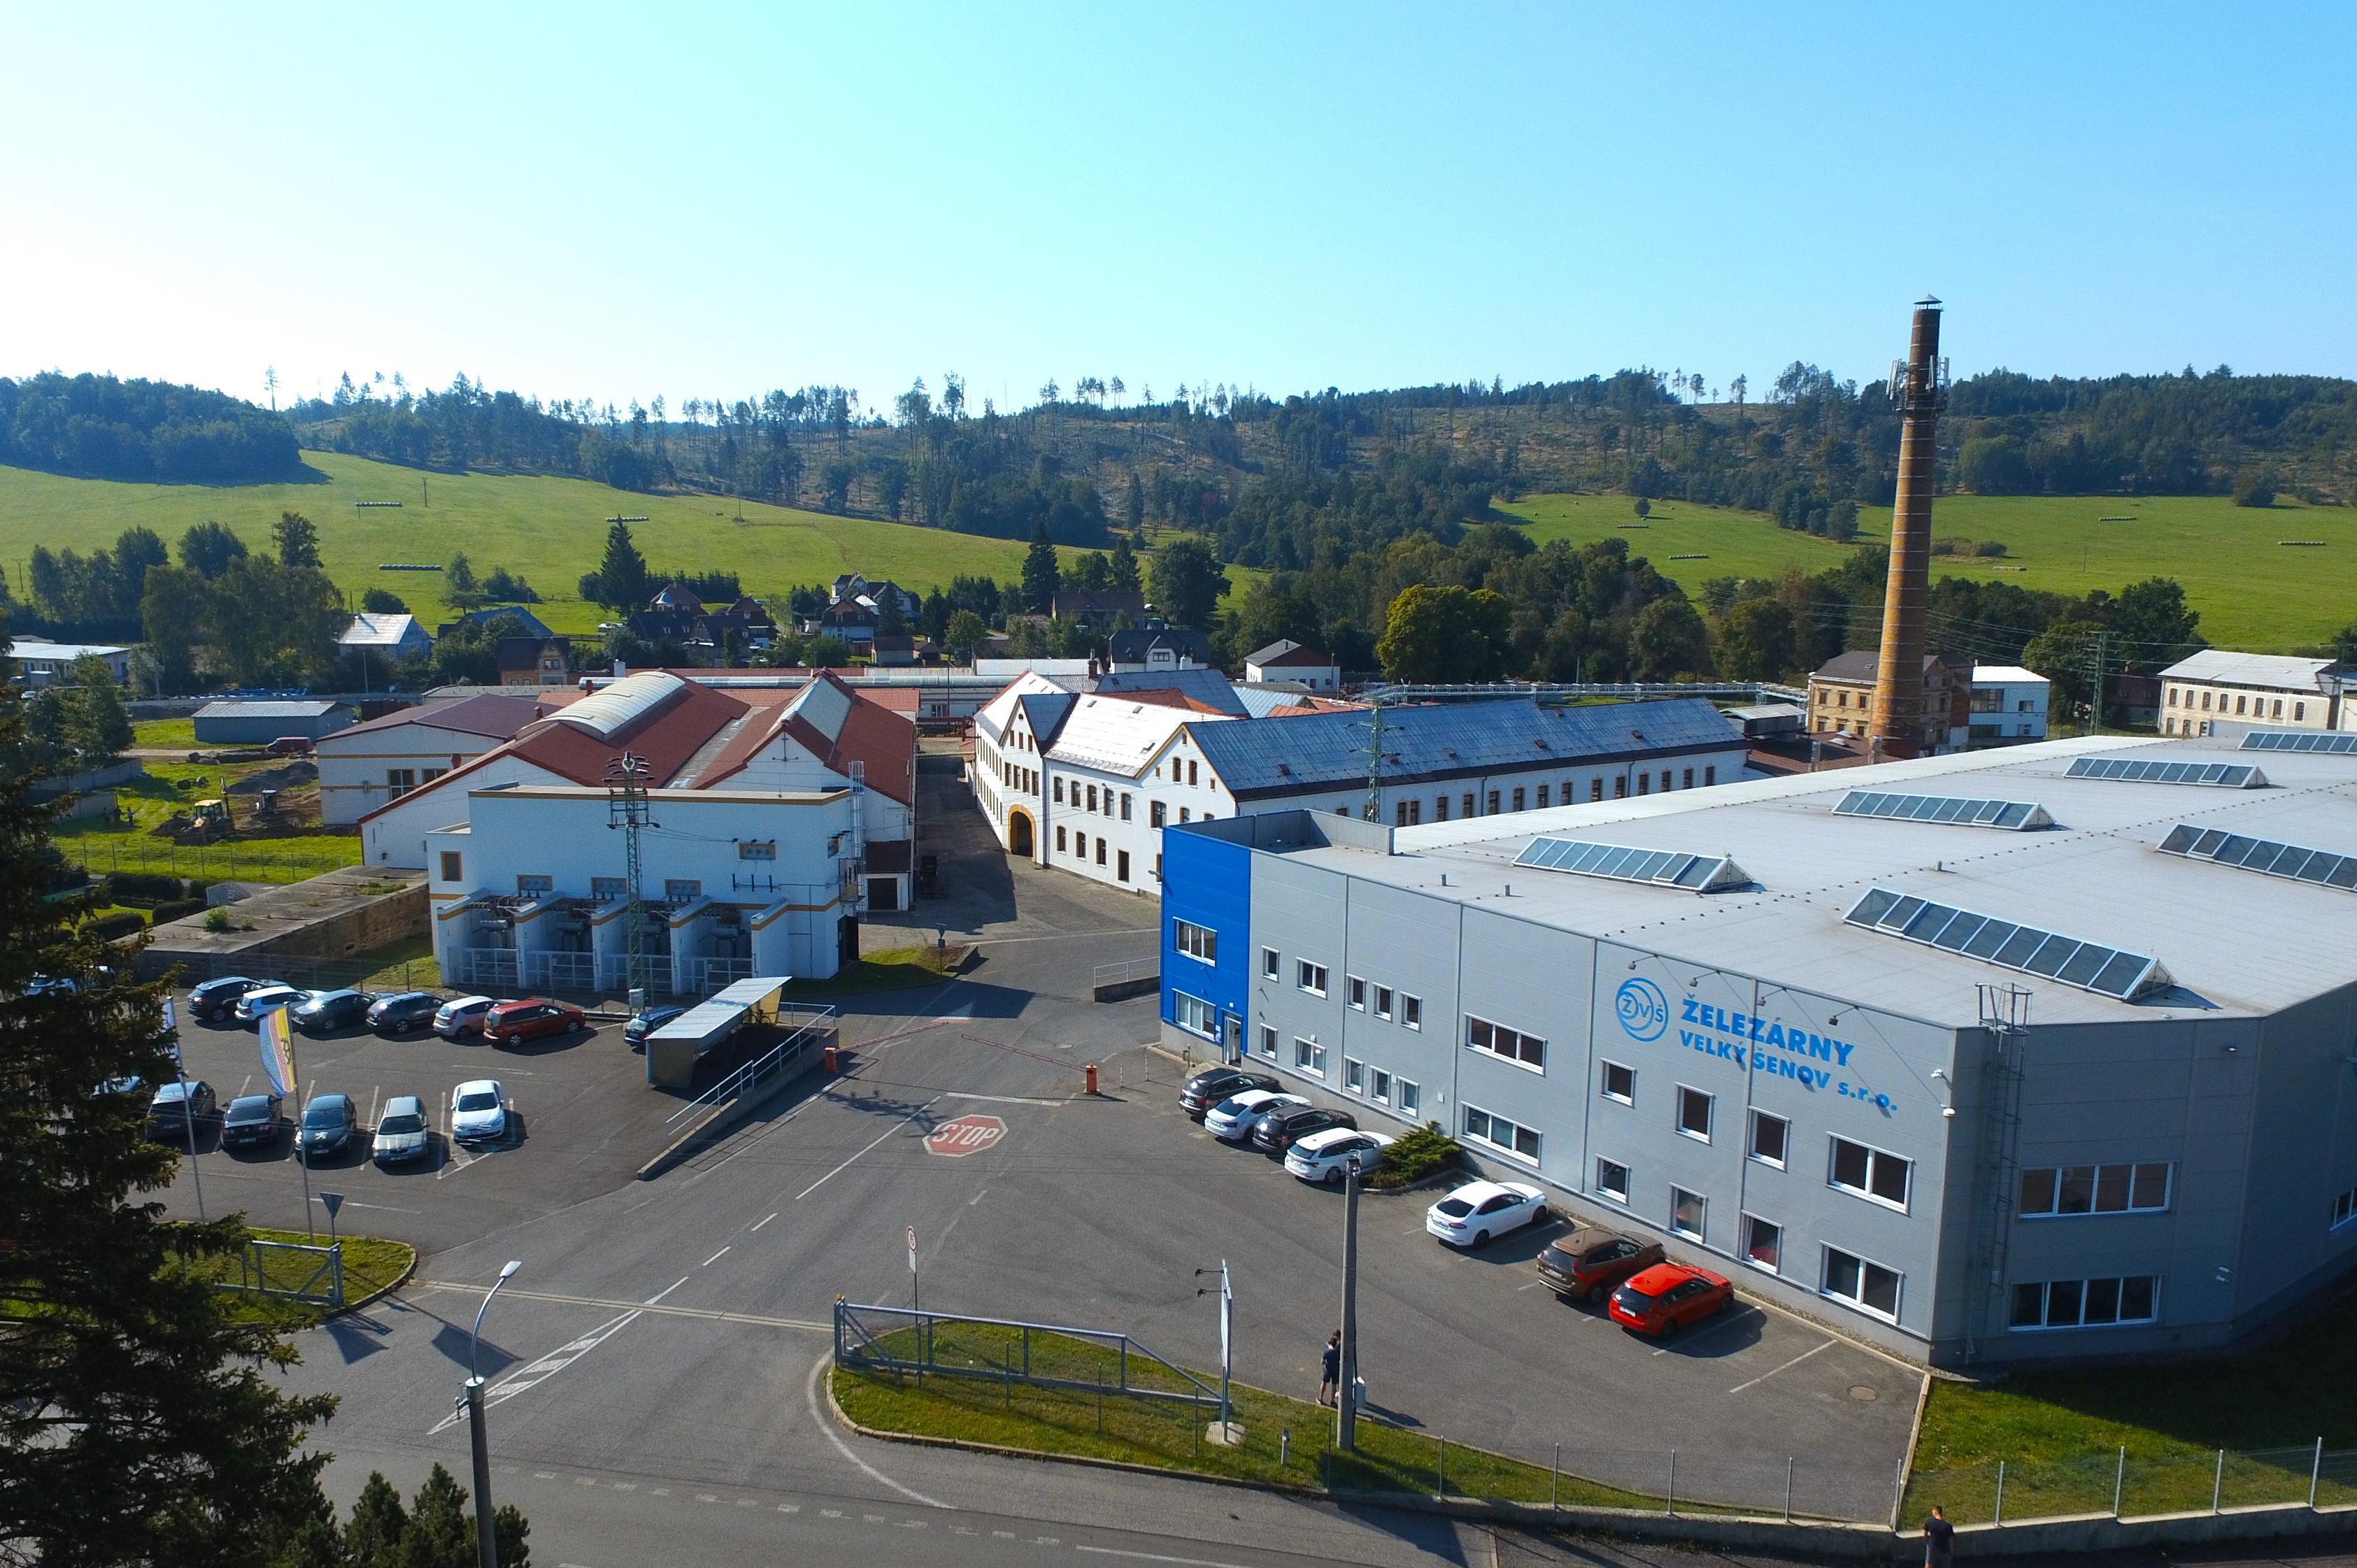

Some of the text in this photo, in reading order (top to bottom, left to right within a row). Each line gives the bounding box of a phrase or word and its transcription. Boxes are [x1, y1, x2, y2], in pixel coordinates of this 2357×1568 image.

[1681, 993, 1854, 1067] ŽELEZÁRNY
[1680, 1029, 1897, 1111] VELKÝ ŠENOV s.r.o.
[932, 1123, 1000, 1146] STOP
